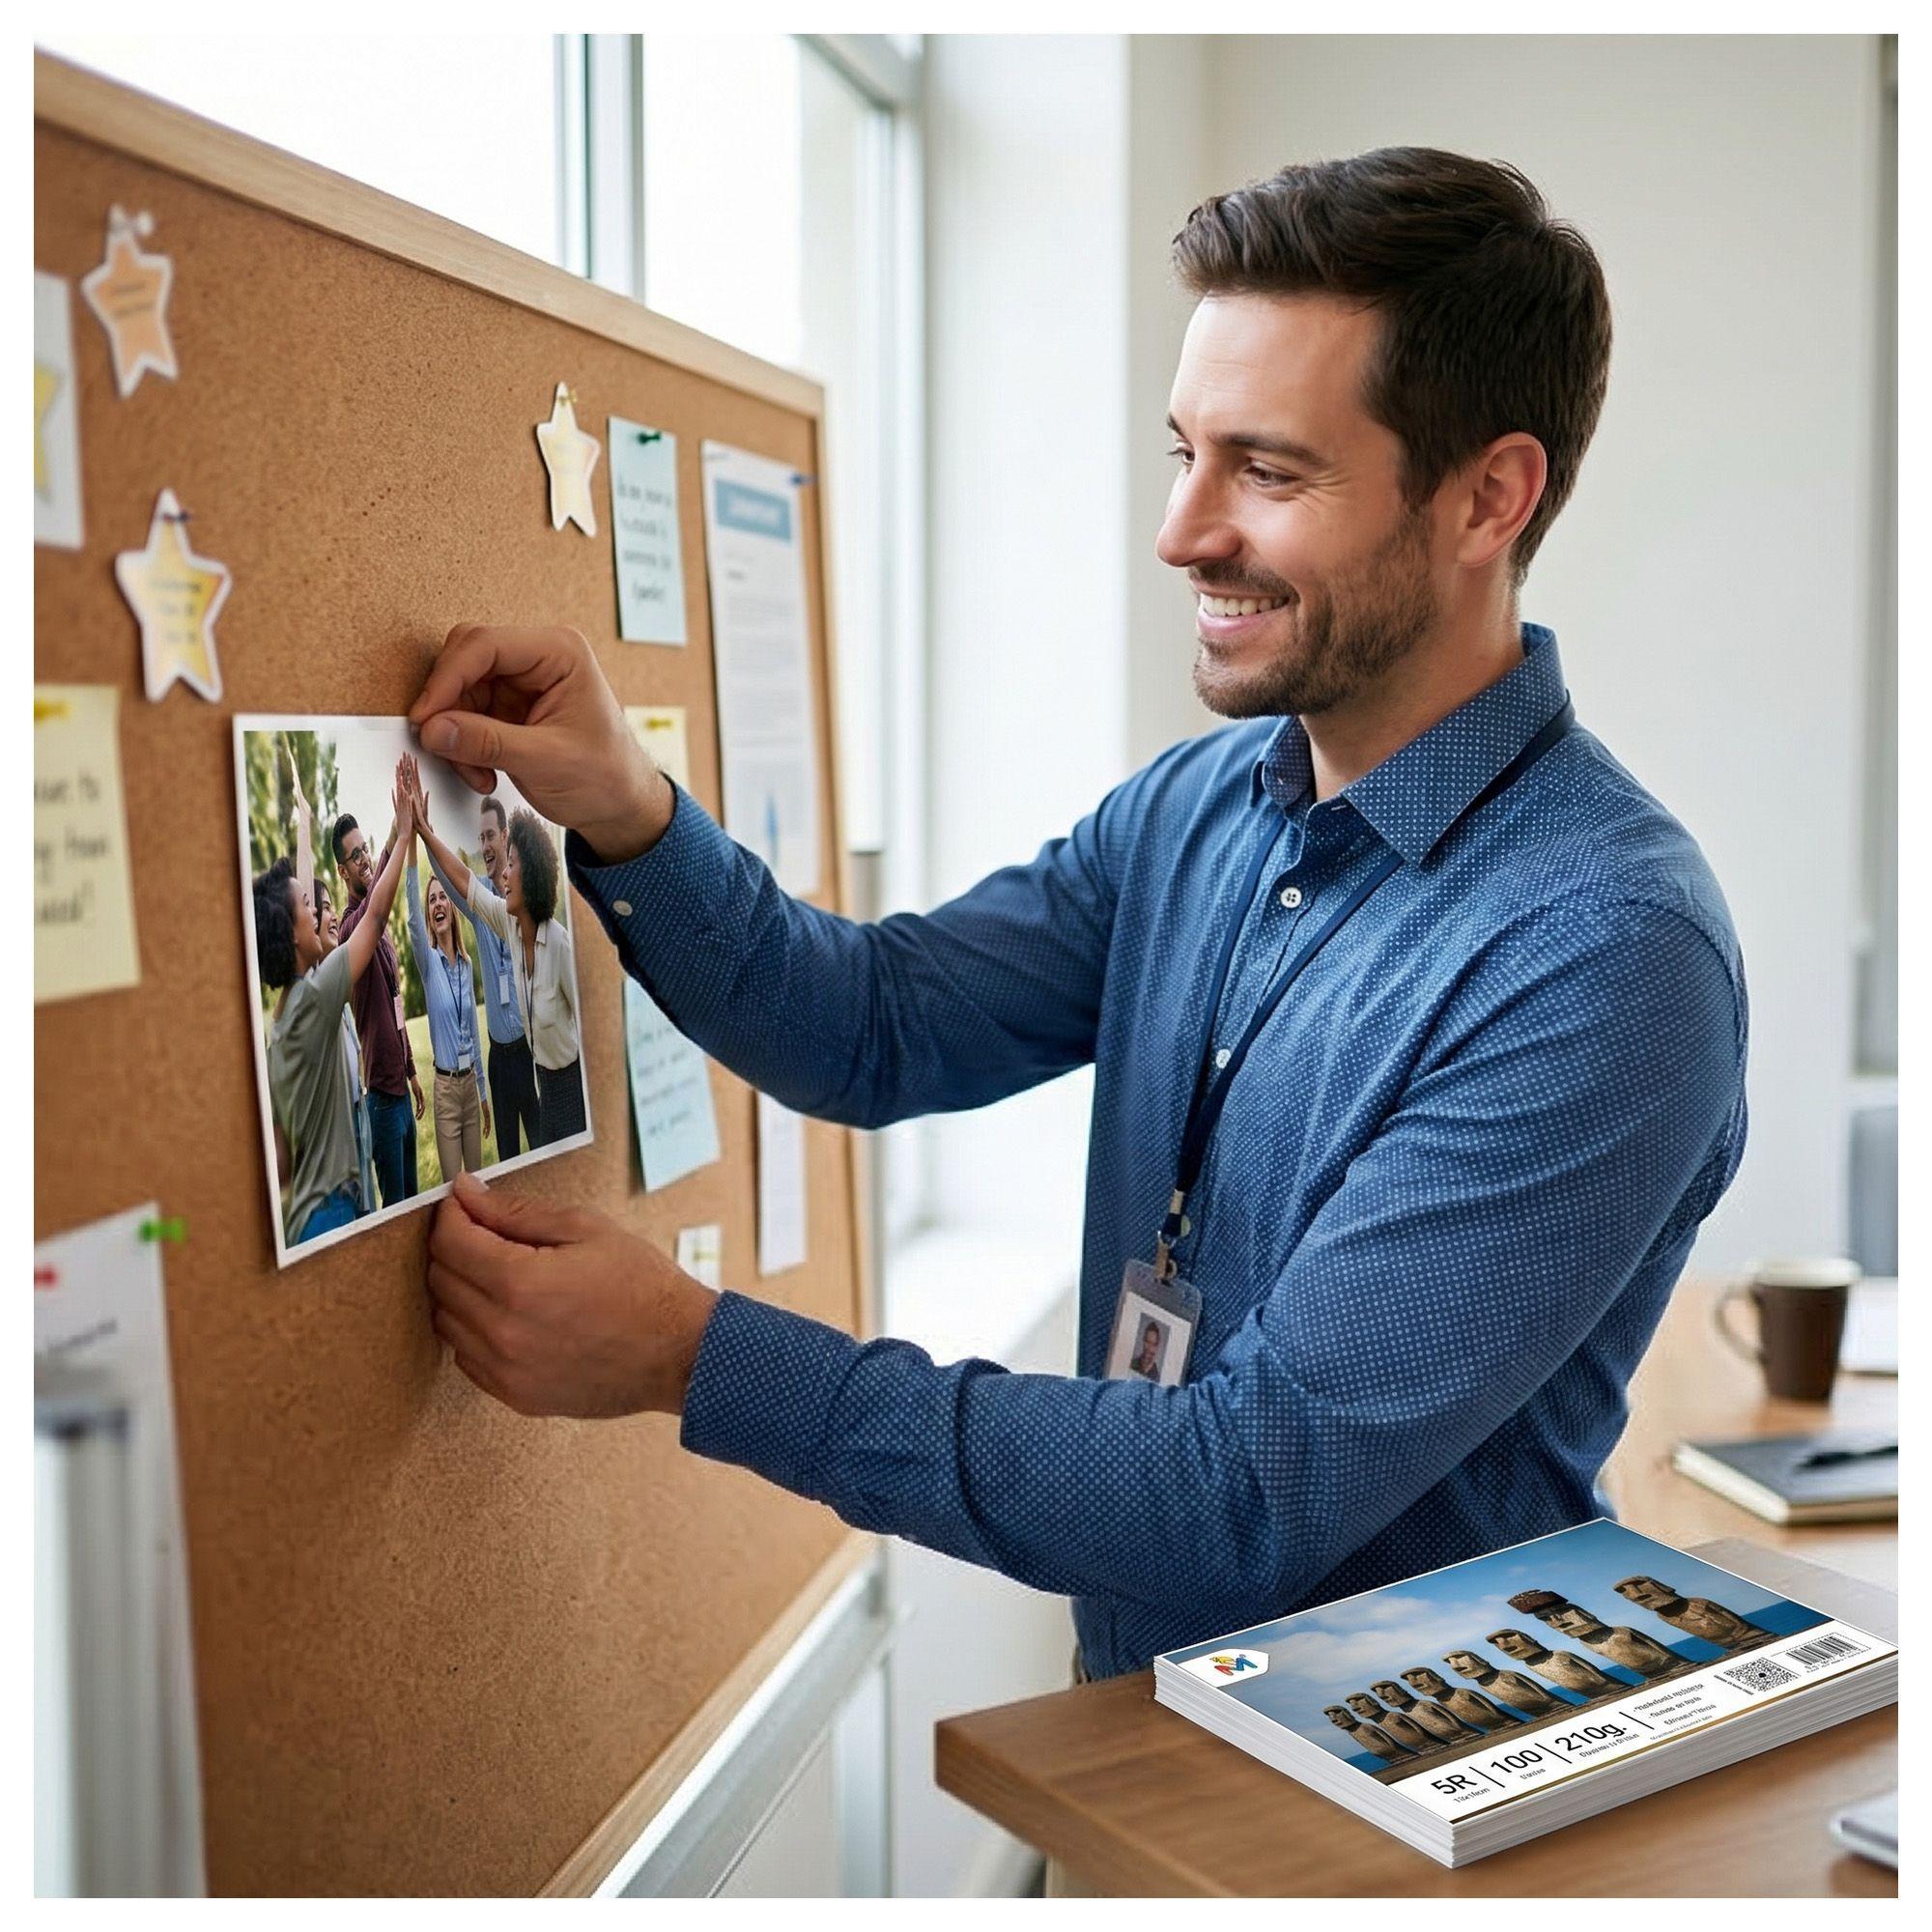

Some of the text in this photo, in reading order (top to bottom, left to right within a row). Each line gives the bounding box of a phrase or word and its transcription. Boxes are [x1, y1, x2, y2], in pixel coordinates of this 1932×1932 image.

[1431, 1774, 1478, 1795] 5R
[1491, 1749, 1543, 1774] 100
[1554, 1723, 1628, 1751] 210g.
